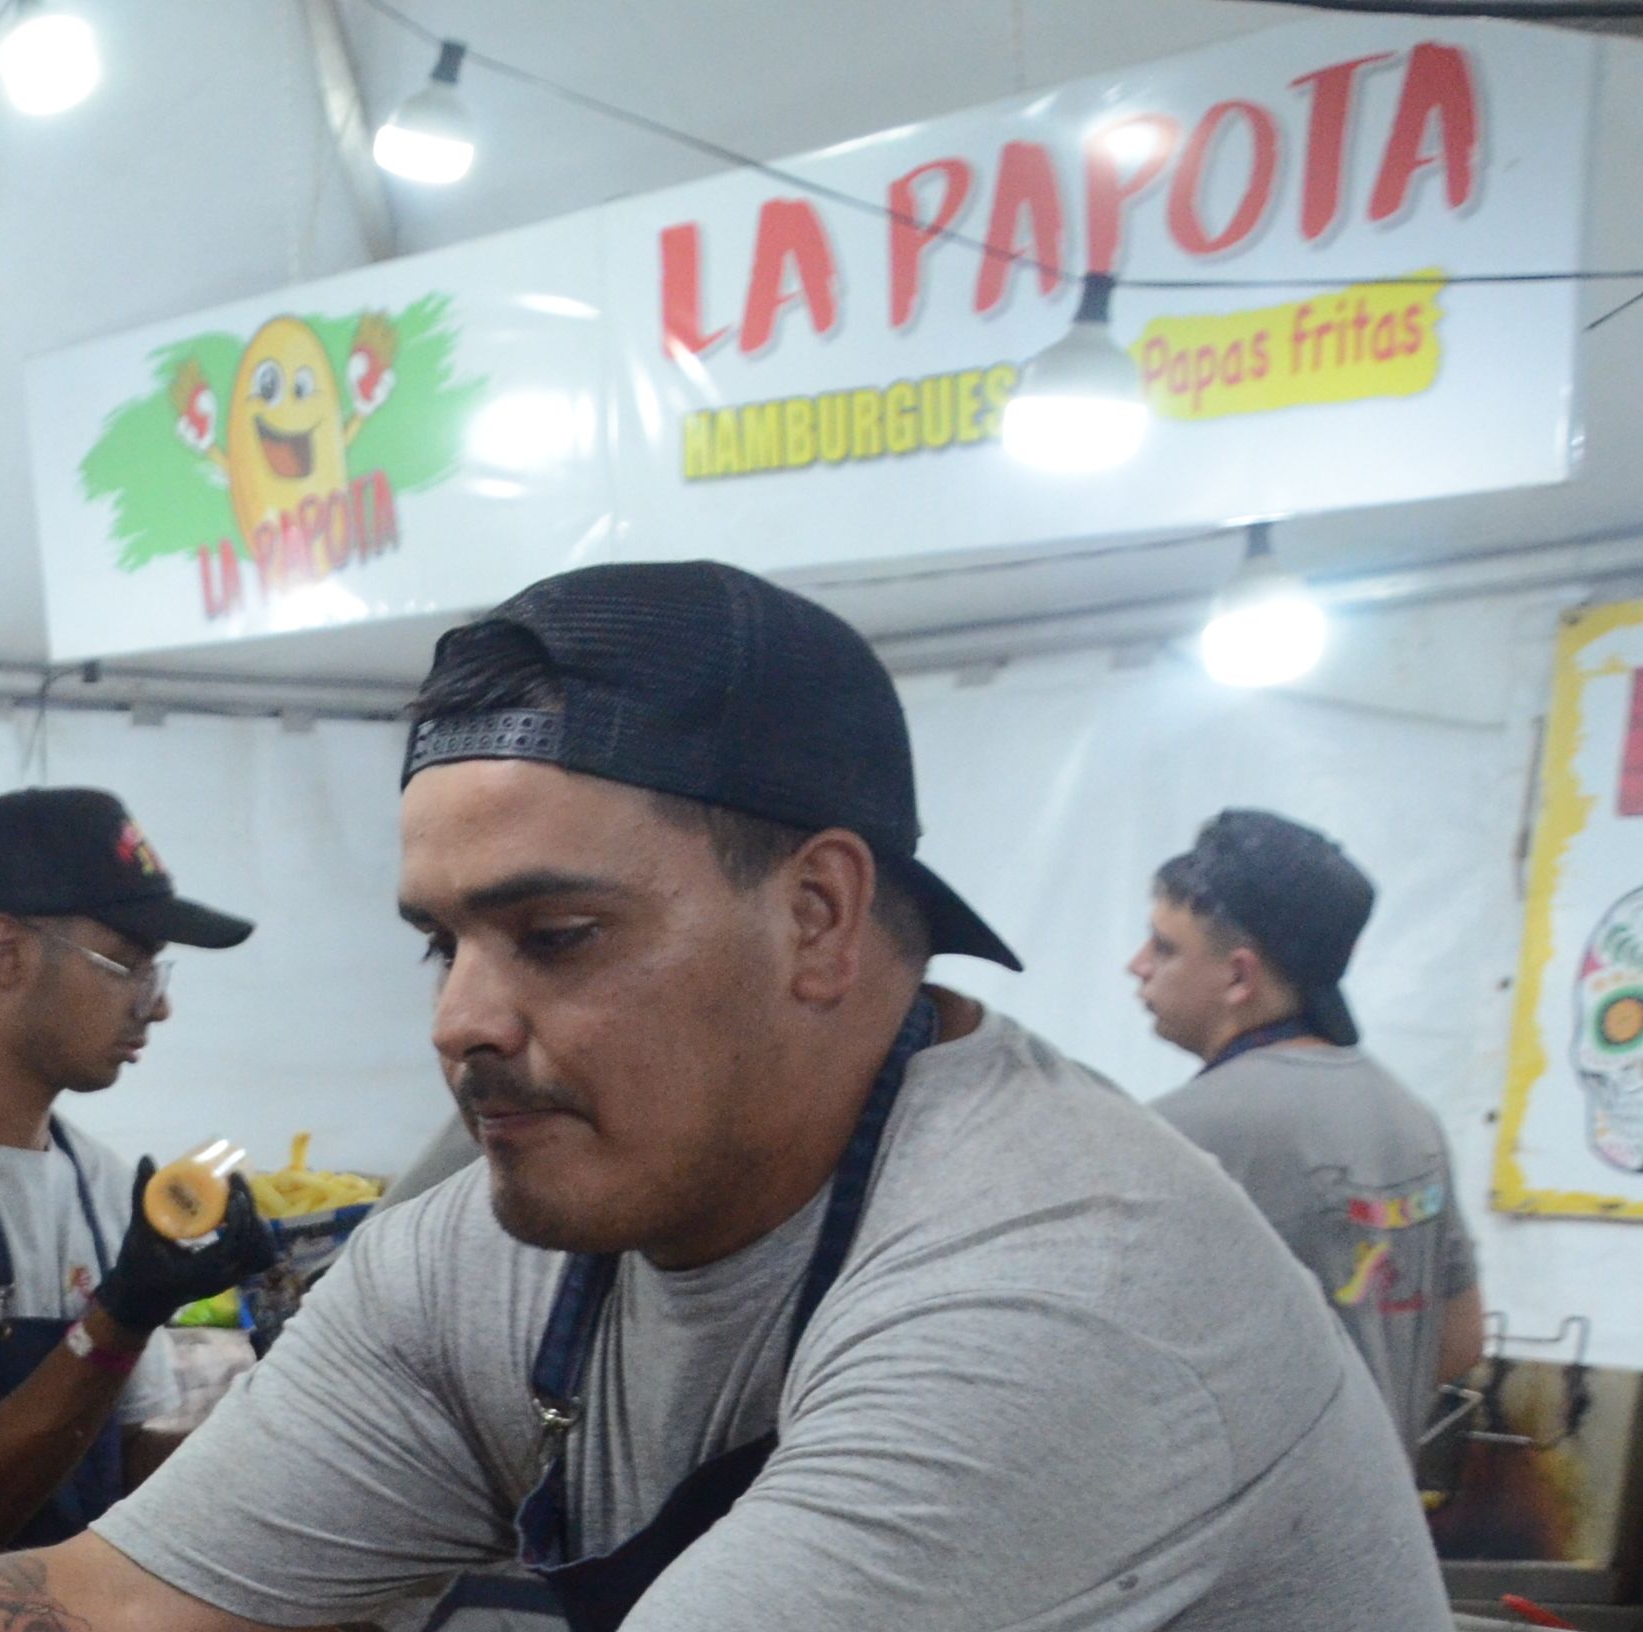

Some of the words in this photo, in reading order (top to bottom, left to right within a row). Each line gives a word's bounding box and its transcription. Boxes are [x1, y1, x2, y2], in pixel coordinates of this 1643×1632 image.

[658, 196, 839, 360] LA
[886, 39, 1483, 331] PAPOTA
[683, 361, 1025, 482] HAMBURGUES
[1140, 329, 1270, 414] Papas
[197, 538, 244, 620] LA
